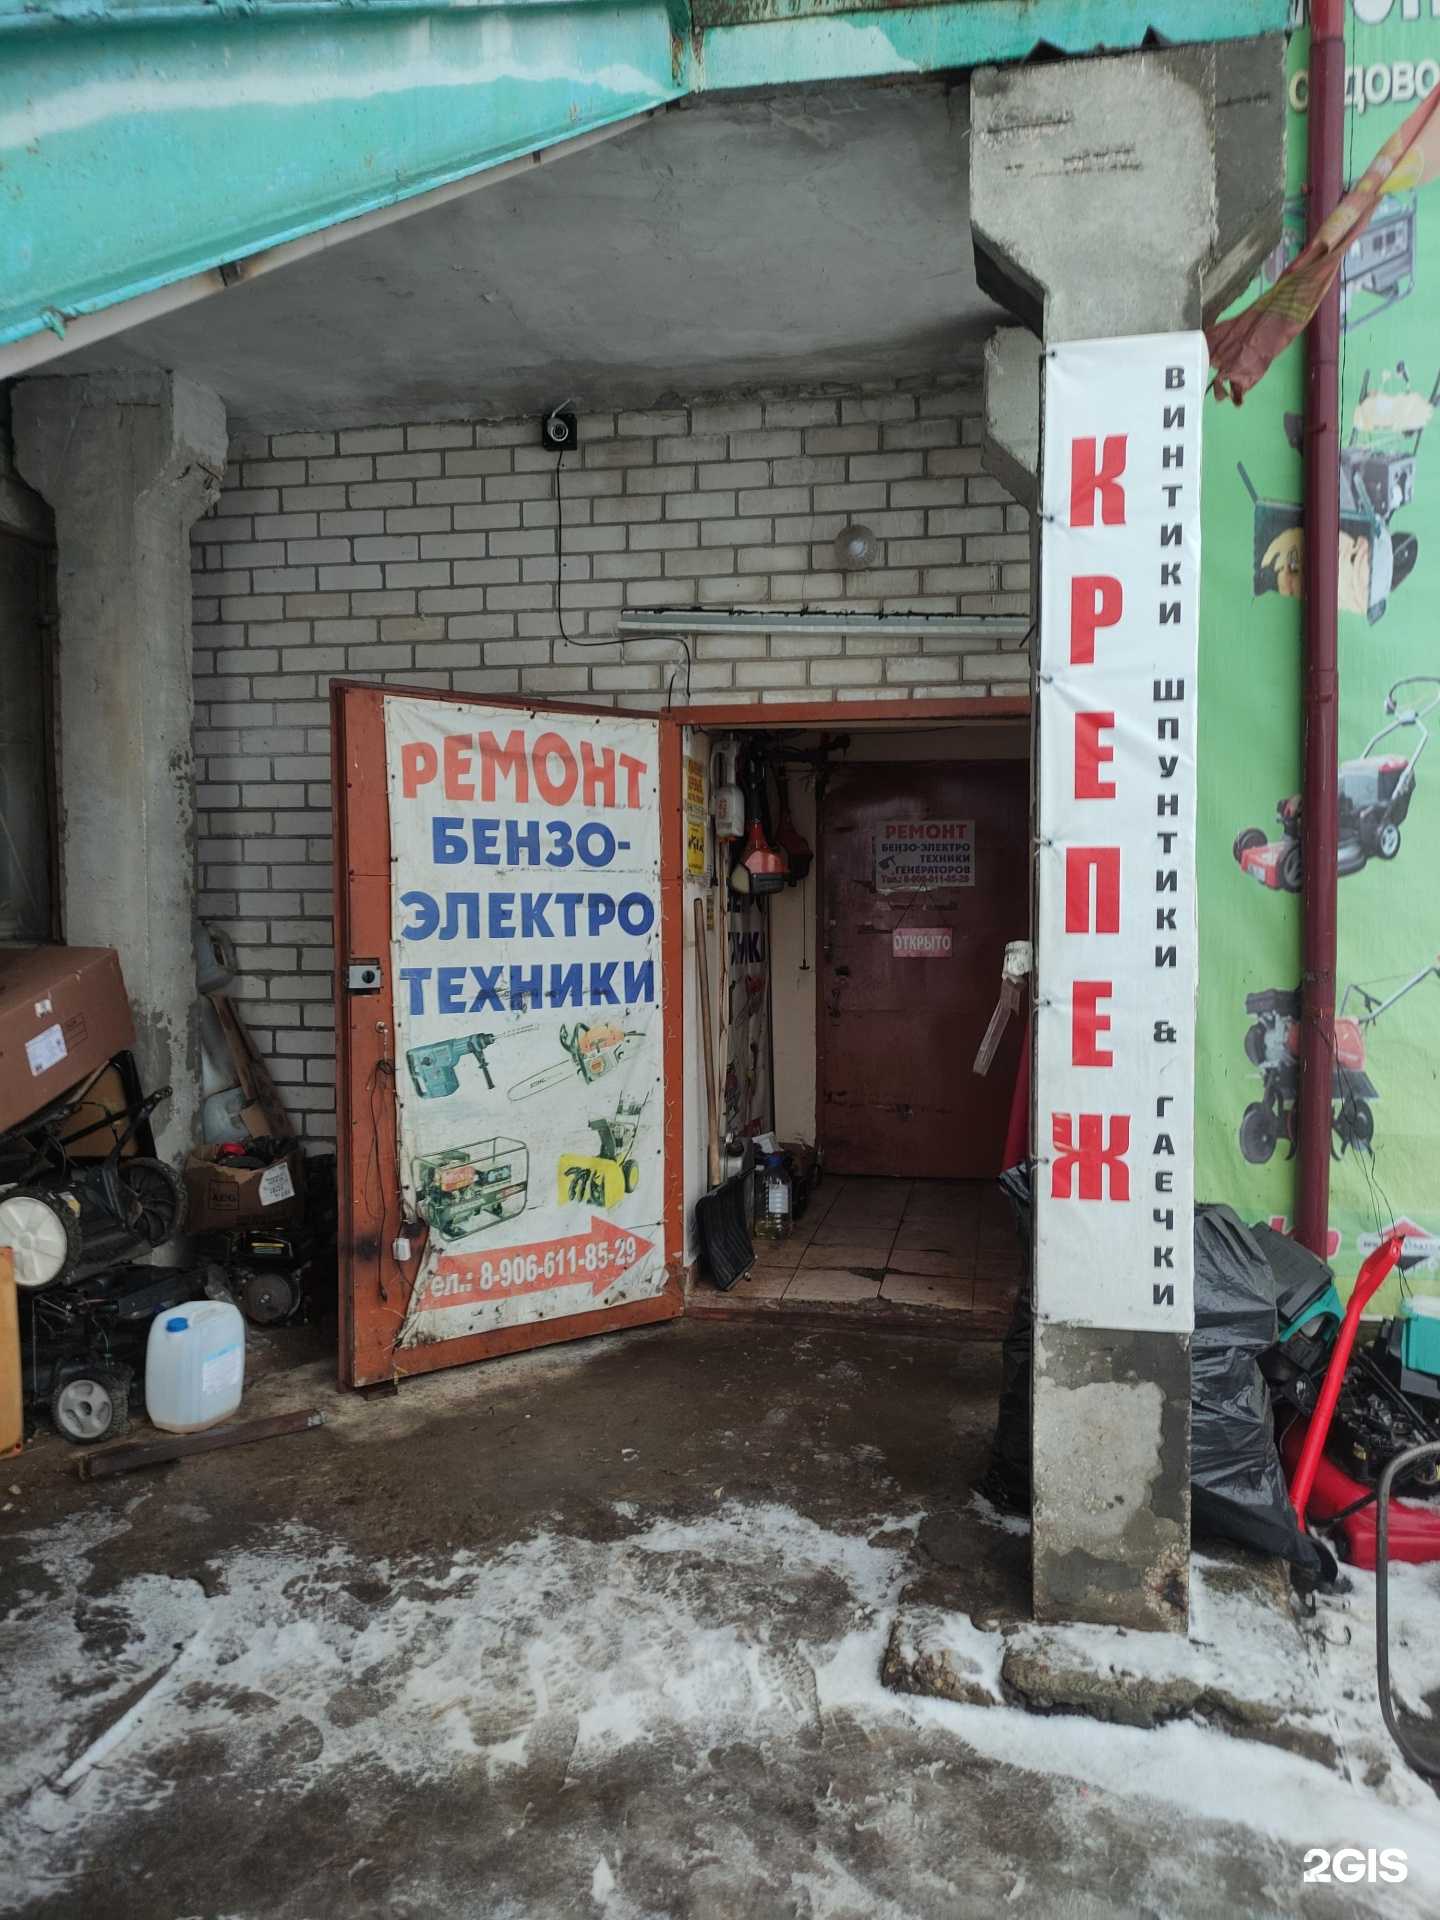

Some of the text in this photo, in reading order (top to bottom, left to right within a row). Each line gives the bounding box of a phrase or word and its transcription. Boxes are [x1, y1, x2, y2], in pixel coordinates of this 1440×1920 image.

[401, 730, 648, 809] РЕМОНТ
[431, 816, 631, 868] БЕНЗО-
[885, 824, 968, 840] РЕМОНТ
[1051, 433, 1130, 1200] КРЕПЕЖ
[1152, 366, 1186, 1305] ВИНТИКИ ШПУНТИКИ & ГАЕЧКИ
[881, 842, 971, 853] БЕНЗО-ЭЛЕКТРО
[895, 865, 971, 874] ГЕНЕРАТОРОВ
[919, 854, 971, 864] ТЕХНИКИ
[400, 891, 655, 941] ЭЛЕКТРО
[893, 935, 951, 950] ОТКРЫТО
[400, 960, 655, 1016] ТЕХНИКИ
[421, 1236, 637, 1299] ел.: 8-906-611-85-29
